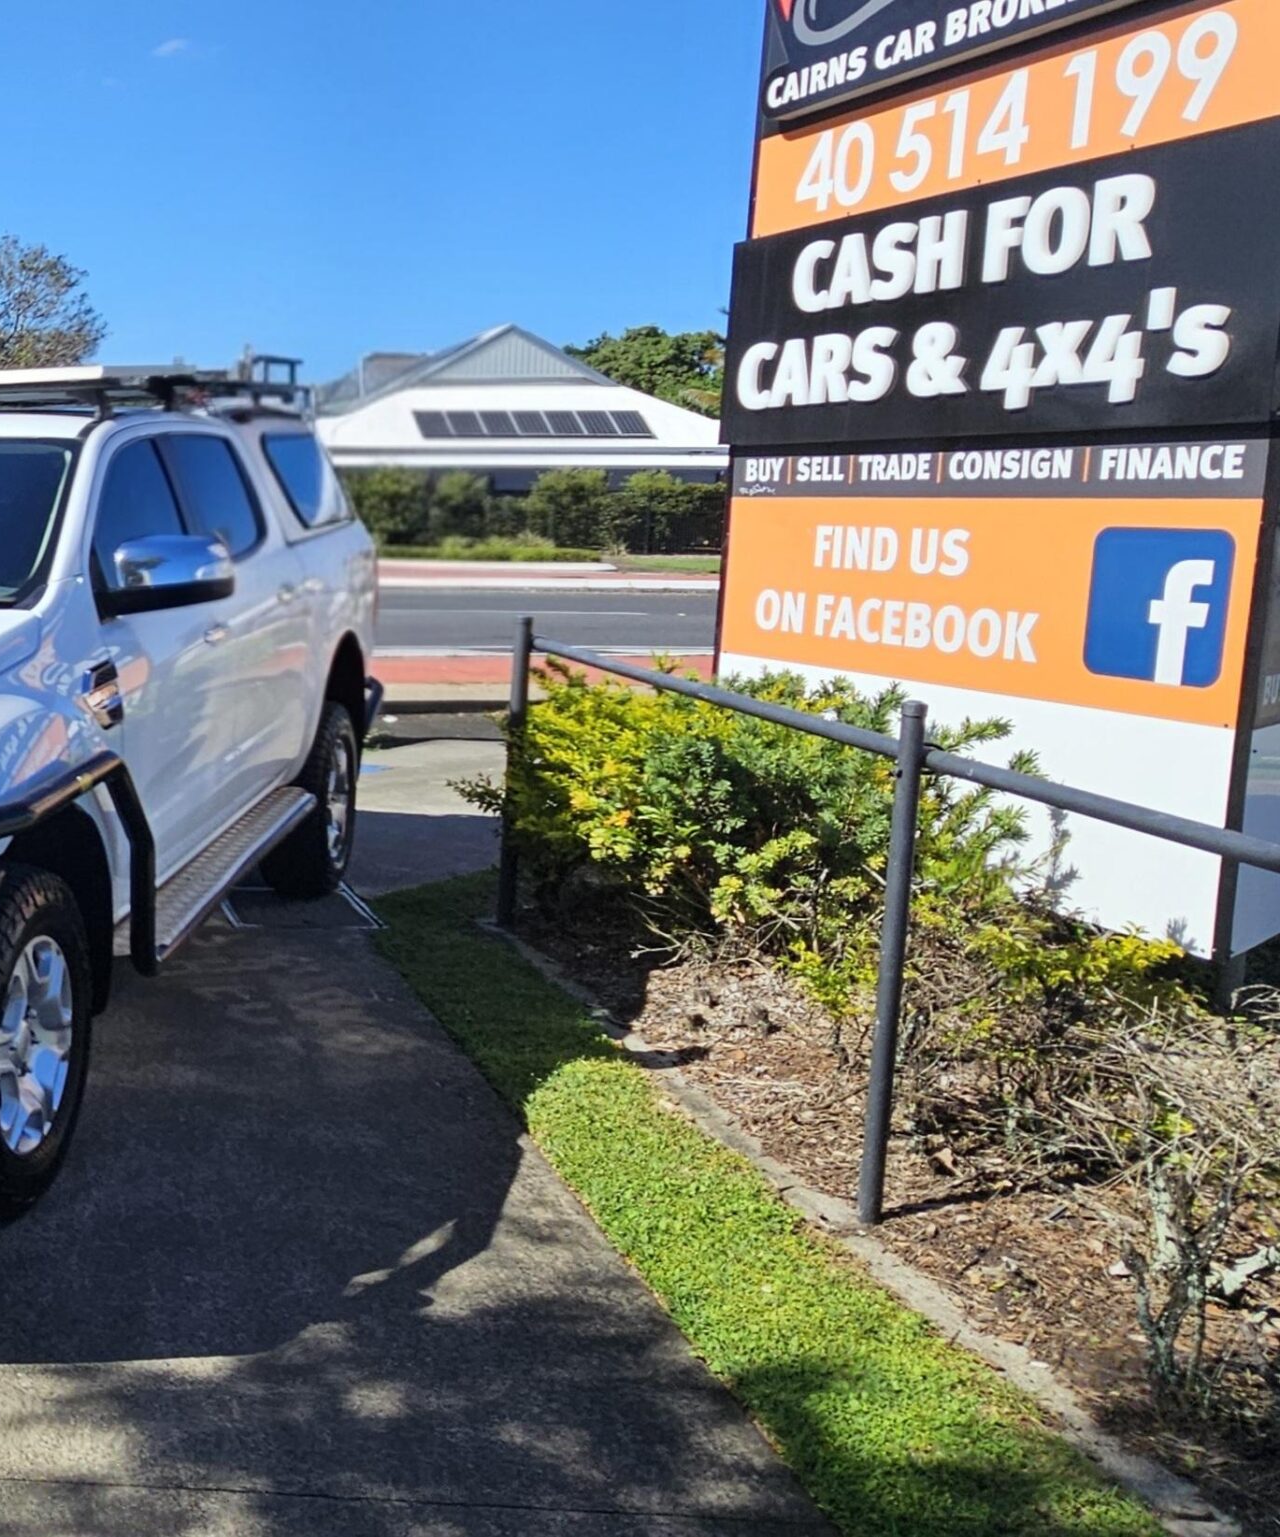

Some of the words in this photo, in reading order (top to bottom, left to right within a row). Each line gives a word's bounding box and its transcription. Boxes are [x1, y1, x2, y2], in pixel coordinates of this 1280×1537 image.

[767, 48, 867, 109] CAIRNS
[874, 19, 936, 70] CAR
[795, 121, 875, 212] 40
[889, 70, 1030, 193] 514
[1063, 12, 1238, 149] 199
[792, 209, 968, 313] CASH
[981, 173, 1155, 283] FOR
[737, 326, 899, 410] CARS
[906, 321, 968, 397] &
[745, 458, 784, 482] BUY
[796, 456, 845, 482] SELL
[858, 453, 931, 481] TRADE
[949, 449, 1073, 481] CONSIGN
[1099, 445, 1246, 480] FINANCE
[813, 525, 898, 572] FIND
[910, 528, 970, 576] US
[755, 589, 806, 634] ON
[815, 594, 1039, 663] FACEBOOK
